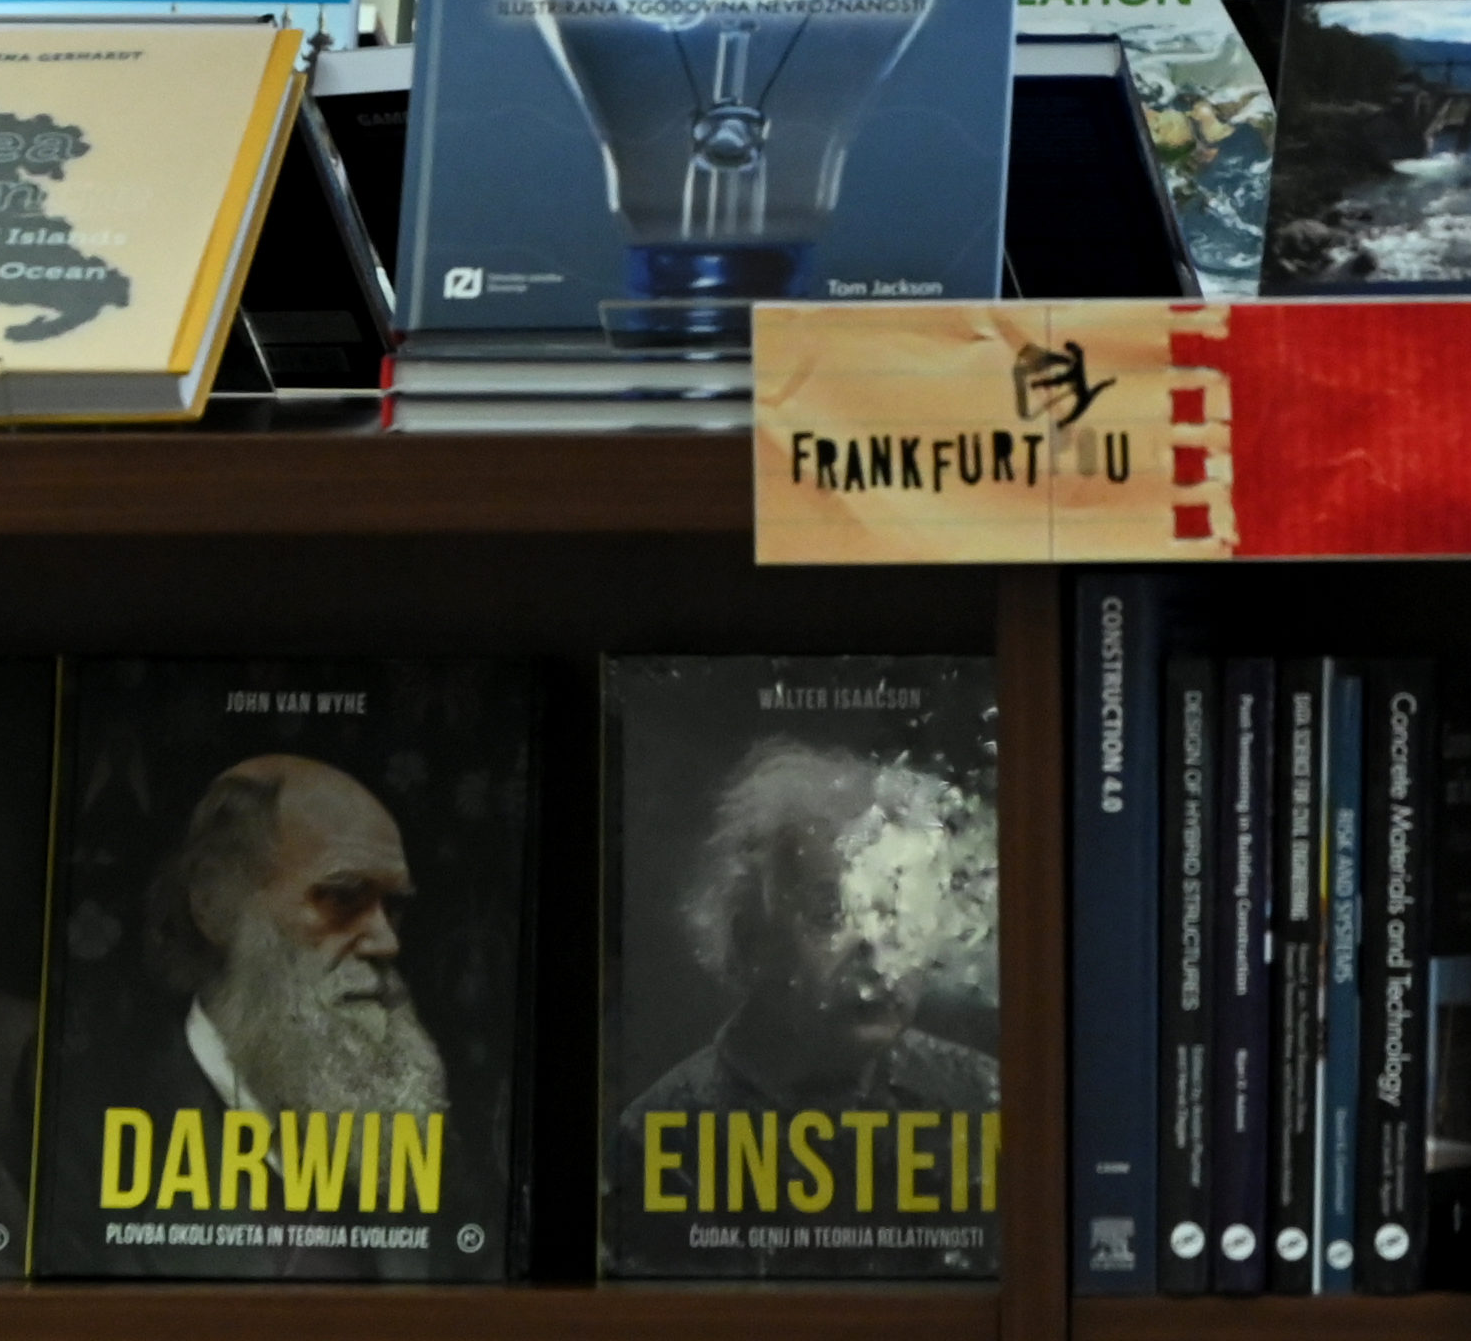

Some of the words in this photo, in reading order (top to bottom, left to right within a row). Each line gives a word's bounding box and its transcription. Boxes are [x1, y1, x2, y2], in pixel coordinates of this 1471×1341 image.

[37, 50, 145, 62] GERHARDT
[5, 228, 130, 247] Islands
[828, 279, 867, 296] Tom
[871, 278, 943, 297] Jackson
[227, 691, 271, 714] JOHN
[276, 691, 311, 714] VAN
[317, 691, 367, 714] WYHE
[758, 687, 829, 711] WALTER
[834, 687, 922, 711] ISAACSON
[1101, 596, 1124, 773] CONSTRUCTION
[1183, 690, 1203, 766] DESIGN
[1388, 691, 1419, 801] Concrete
[1183, 768, 1203, 796] OF
[1183, 799, 1202, 877] HYBRID
[1237, 816, 1250, 832] in
[1335, 808, 1356, 848] RISK
[1234, 833, 1254, 898] Building
[1334, 850, 1355, 899] AND
[1387, 803, 1414, 916] Materials
[1180, 878, 1202, 1012] STRUCTURES
[1234, 899, 1253, 996] Construction
[1333, 901, 1354, 984] SYSTEMS
[1386, 918, 1413, 969] and
[1376, 973, 1413, 1108] Technology
[100, 1107, 443, 1213] DARWIN
[105, 1223, 166, 1245] PLOVBA
[215, 1224, 264, 1246] SVETA
[287, 1224, 348, 1247] TEORIJA
[350, 1225, 429, 1248] EVOLUCIJE
